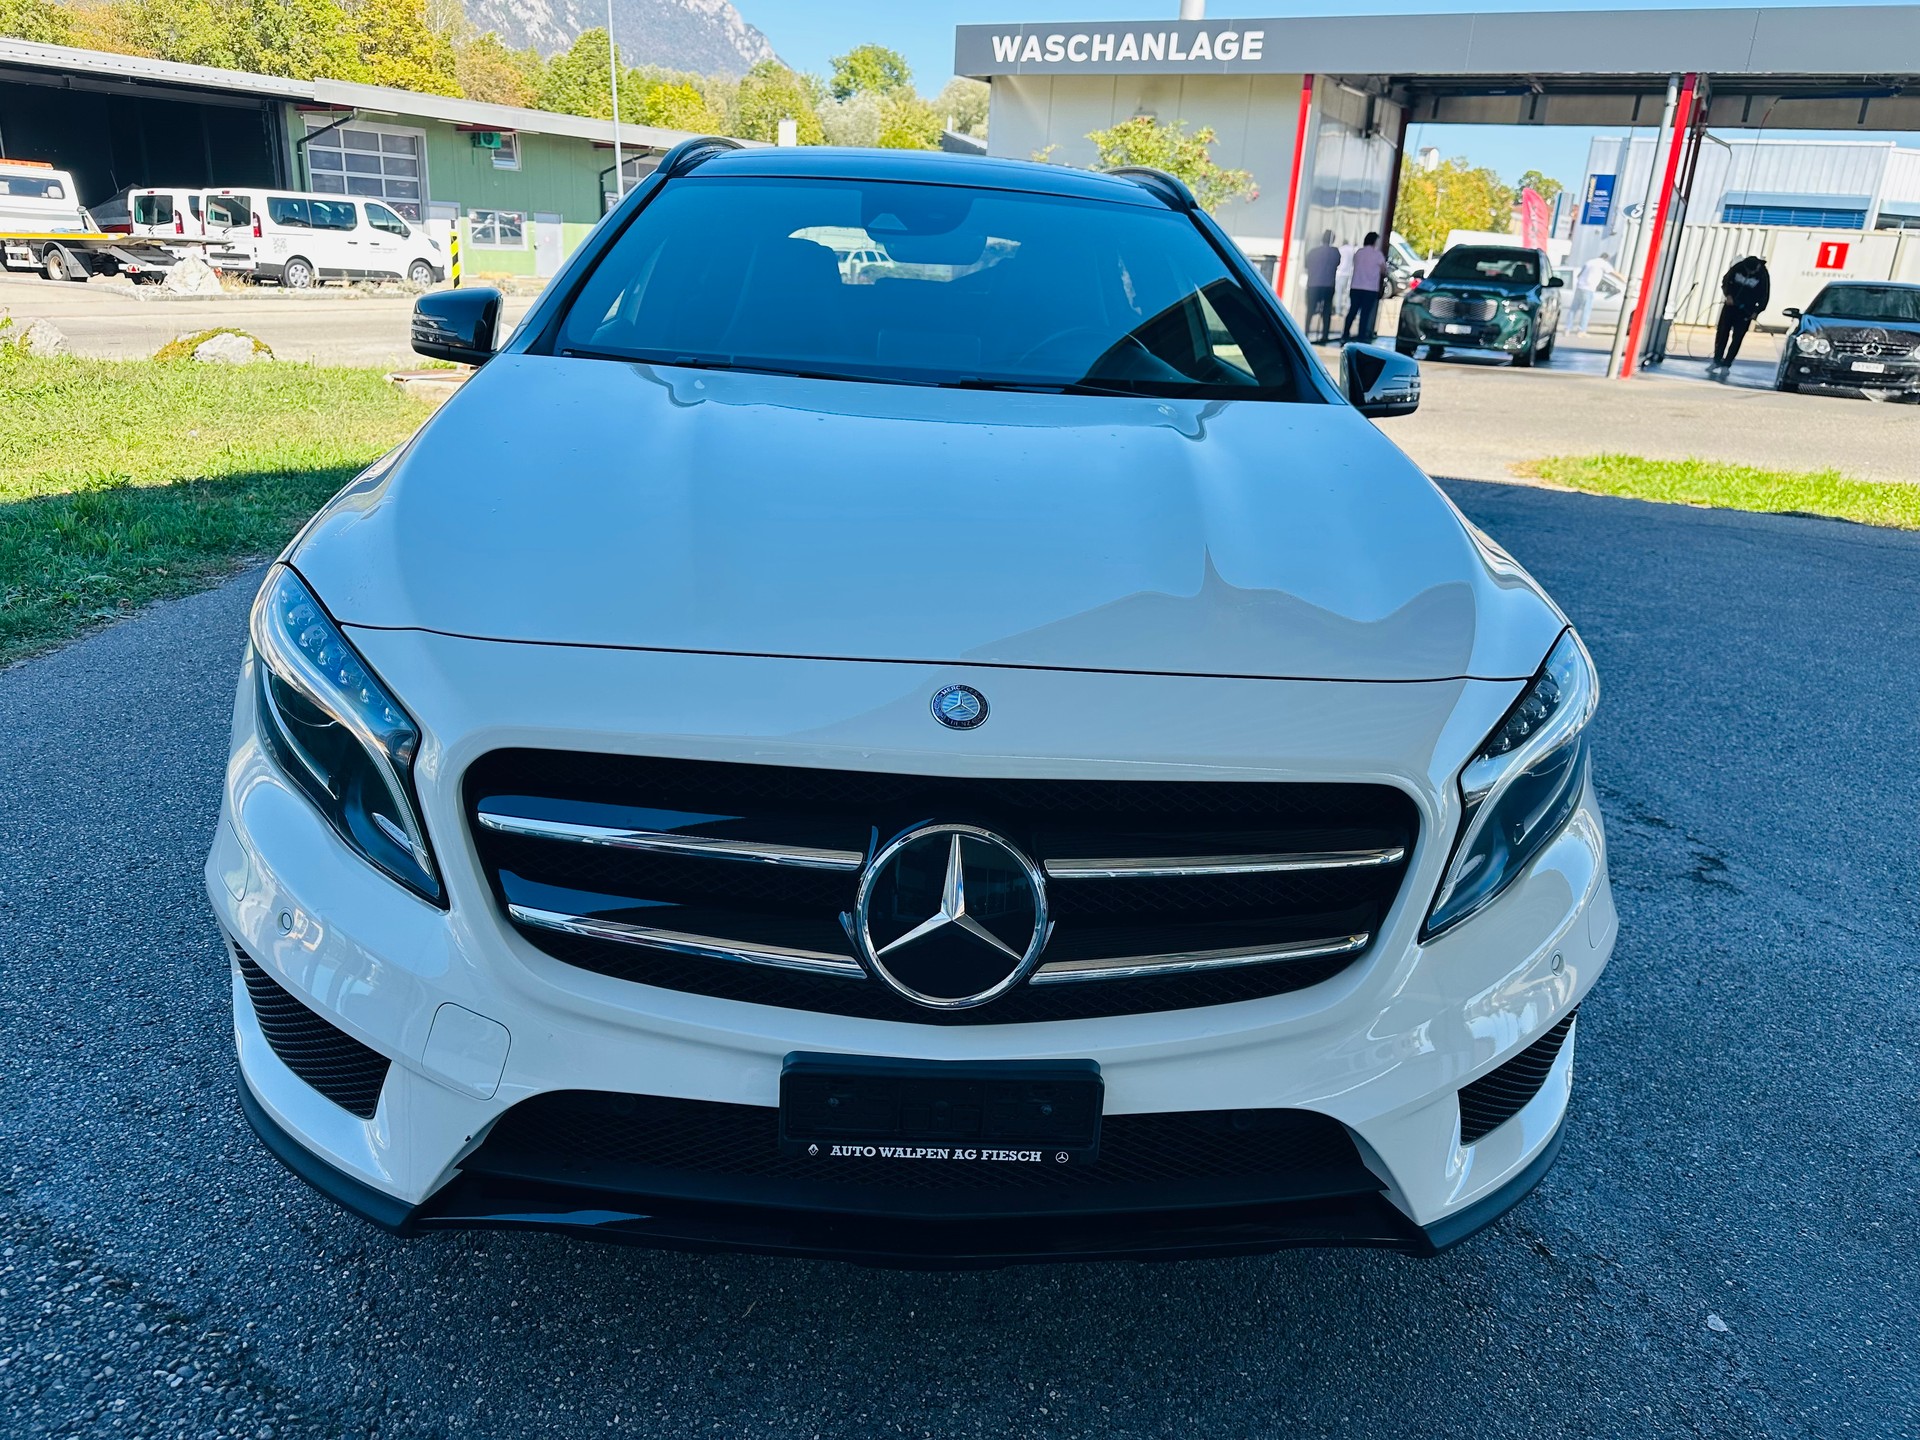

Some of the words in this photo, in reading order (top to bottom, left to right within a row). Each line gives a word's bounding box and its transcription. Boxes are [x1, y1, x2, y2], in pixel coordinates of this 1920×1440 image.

[992, 31, 1265, 63] WASCHANLAGE
[1827, 245, 1838, 266] 1
[830, 1145, 877, 1158] AUTO
[879, 1146, 949, 1160] WALPEN
[952, 1149, 978, 1161] AG
[981, 1149, 1042, 1162] FIESCH
